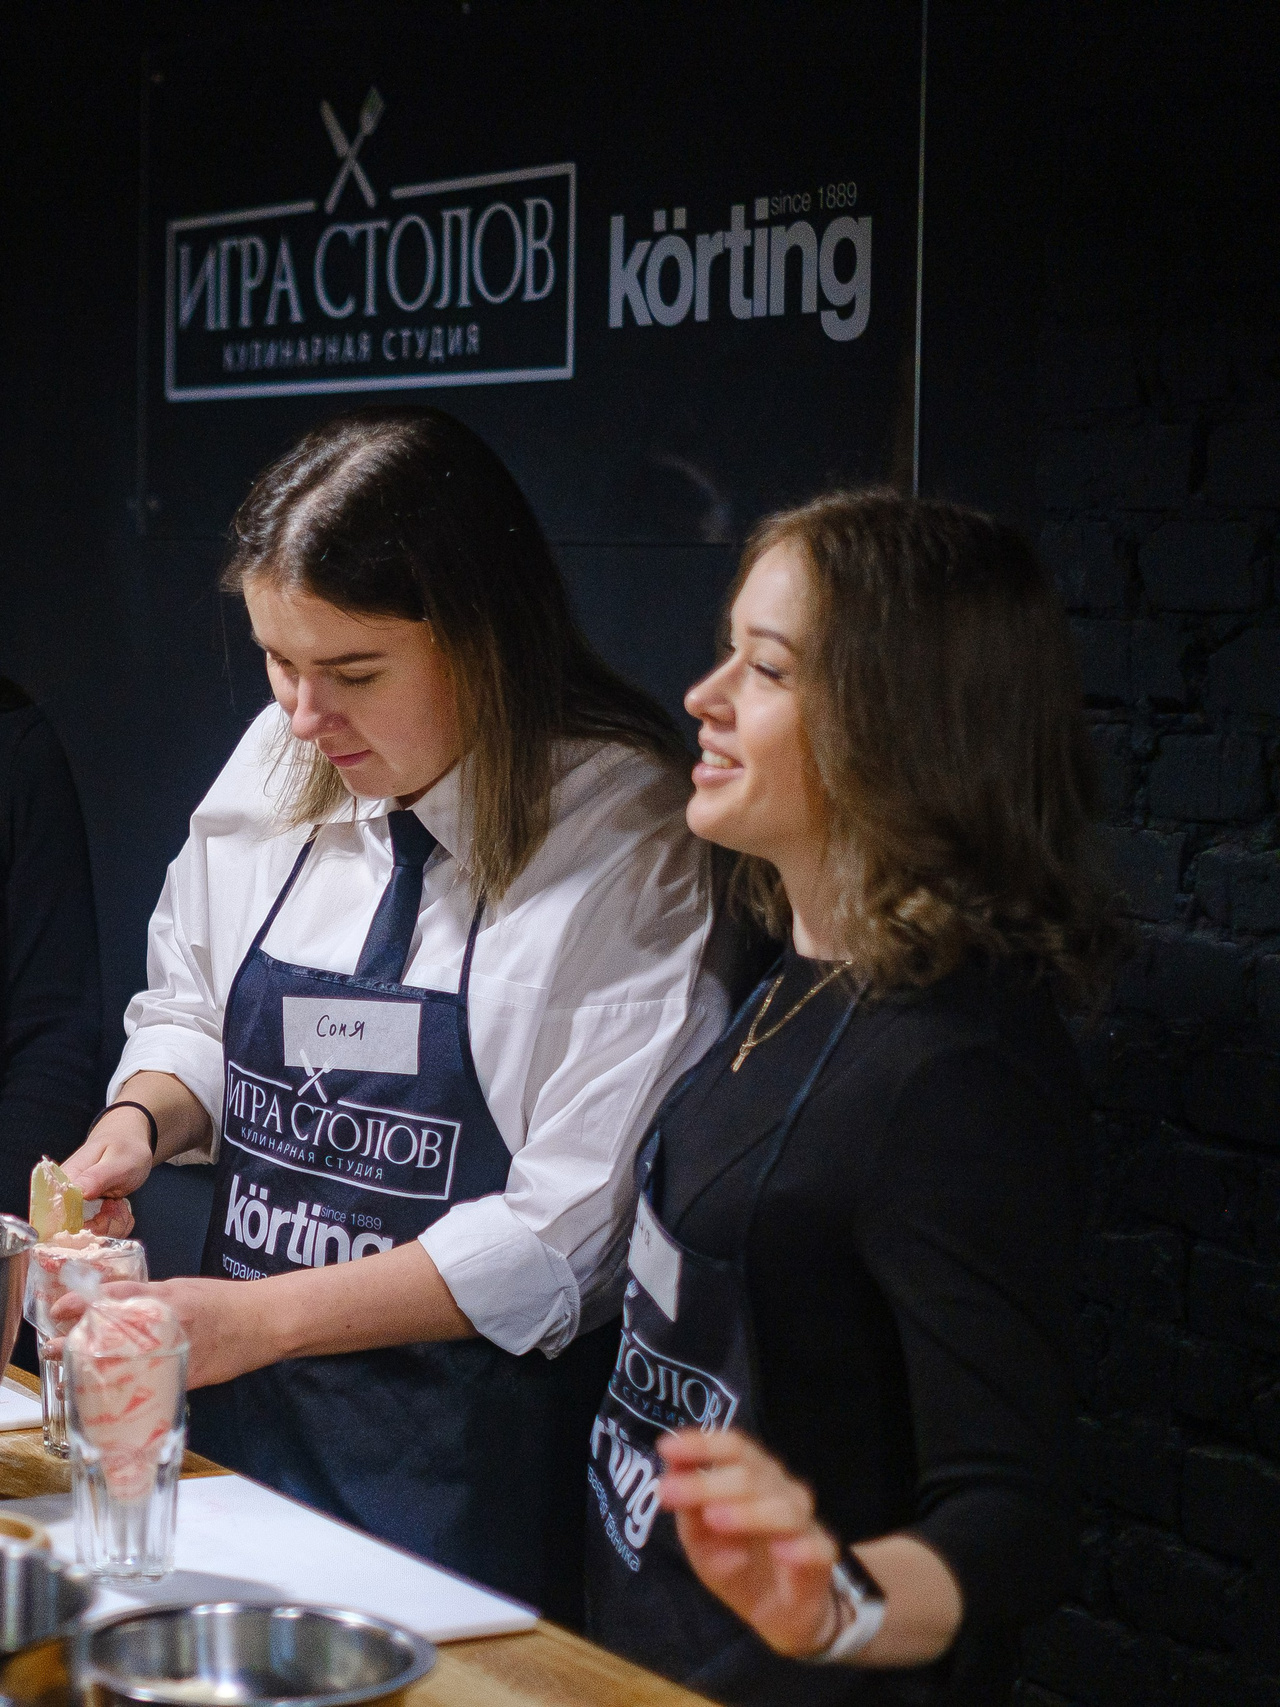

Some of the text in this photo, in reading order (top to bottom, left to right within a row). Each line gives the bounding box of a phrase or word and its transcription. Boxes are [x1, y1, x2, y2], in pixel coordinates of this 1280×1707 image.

[770, 181, 858, 216] since 1889
[178, 198, 556, 331] ИГРА СТОЛОВ
[609, 197, 872, 341] körting
[222, 321, 480, 372] КУЛИНАРНАЯ СТУДИЯ
[316, 1014, 366, 1041] Соня
[229, 1073, 442, 1169] ИГРА СТОЛОВ
[241, 1126, 383, 1180] КУЛИНАРНАЯ СТУДИЯ
[320, 1206, 382, 1230] since 1889
[616, 1329, 721, 1435] ТОЛОВ
